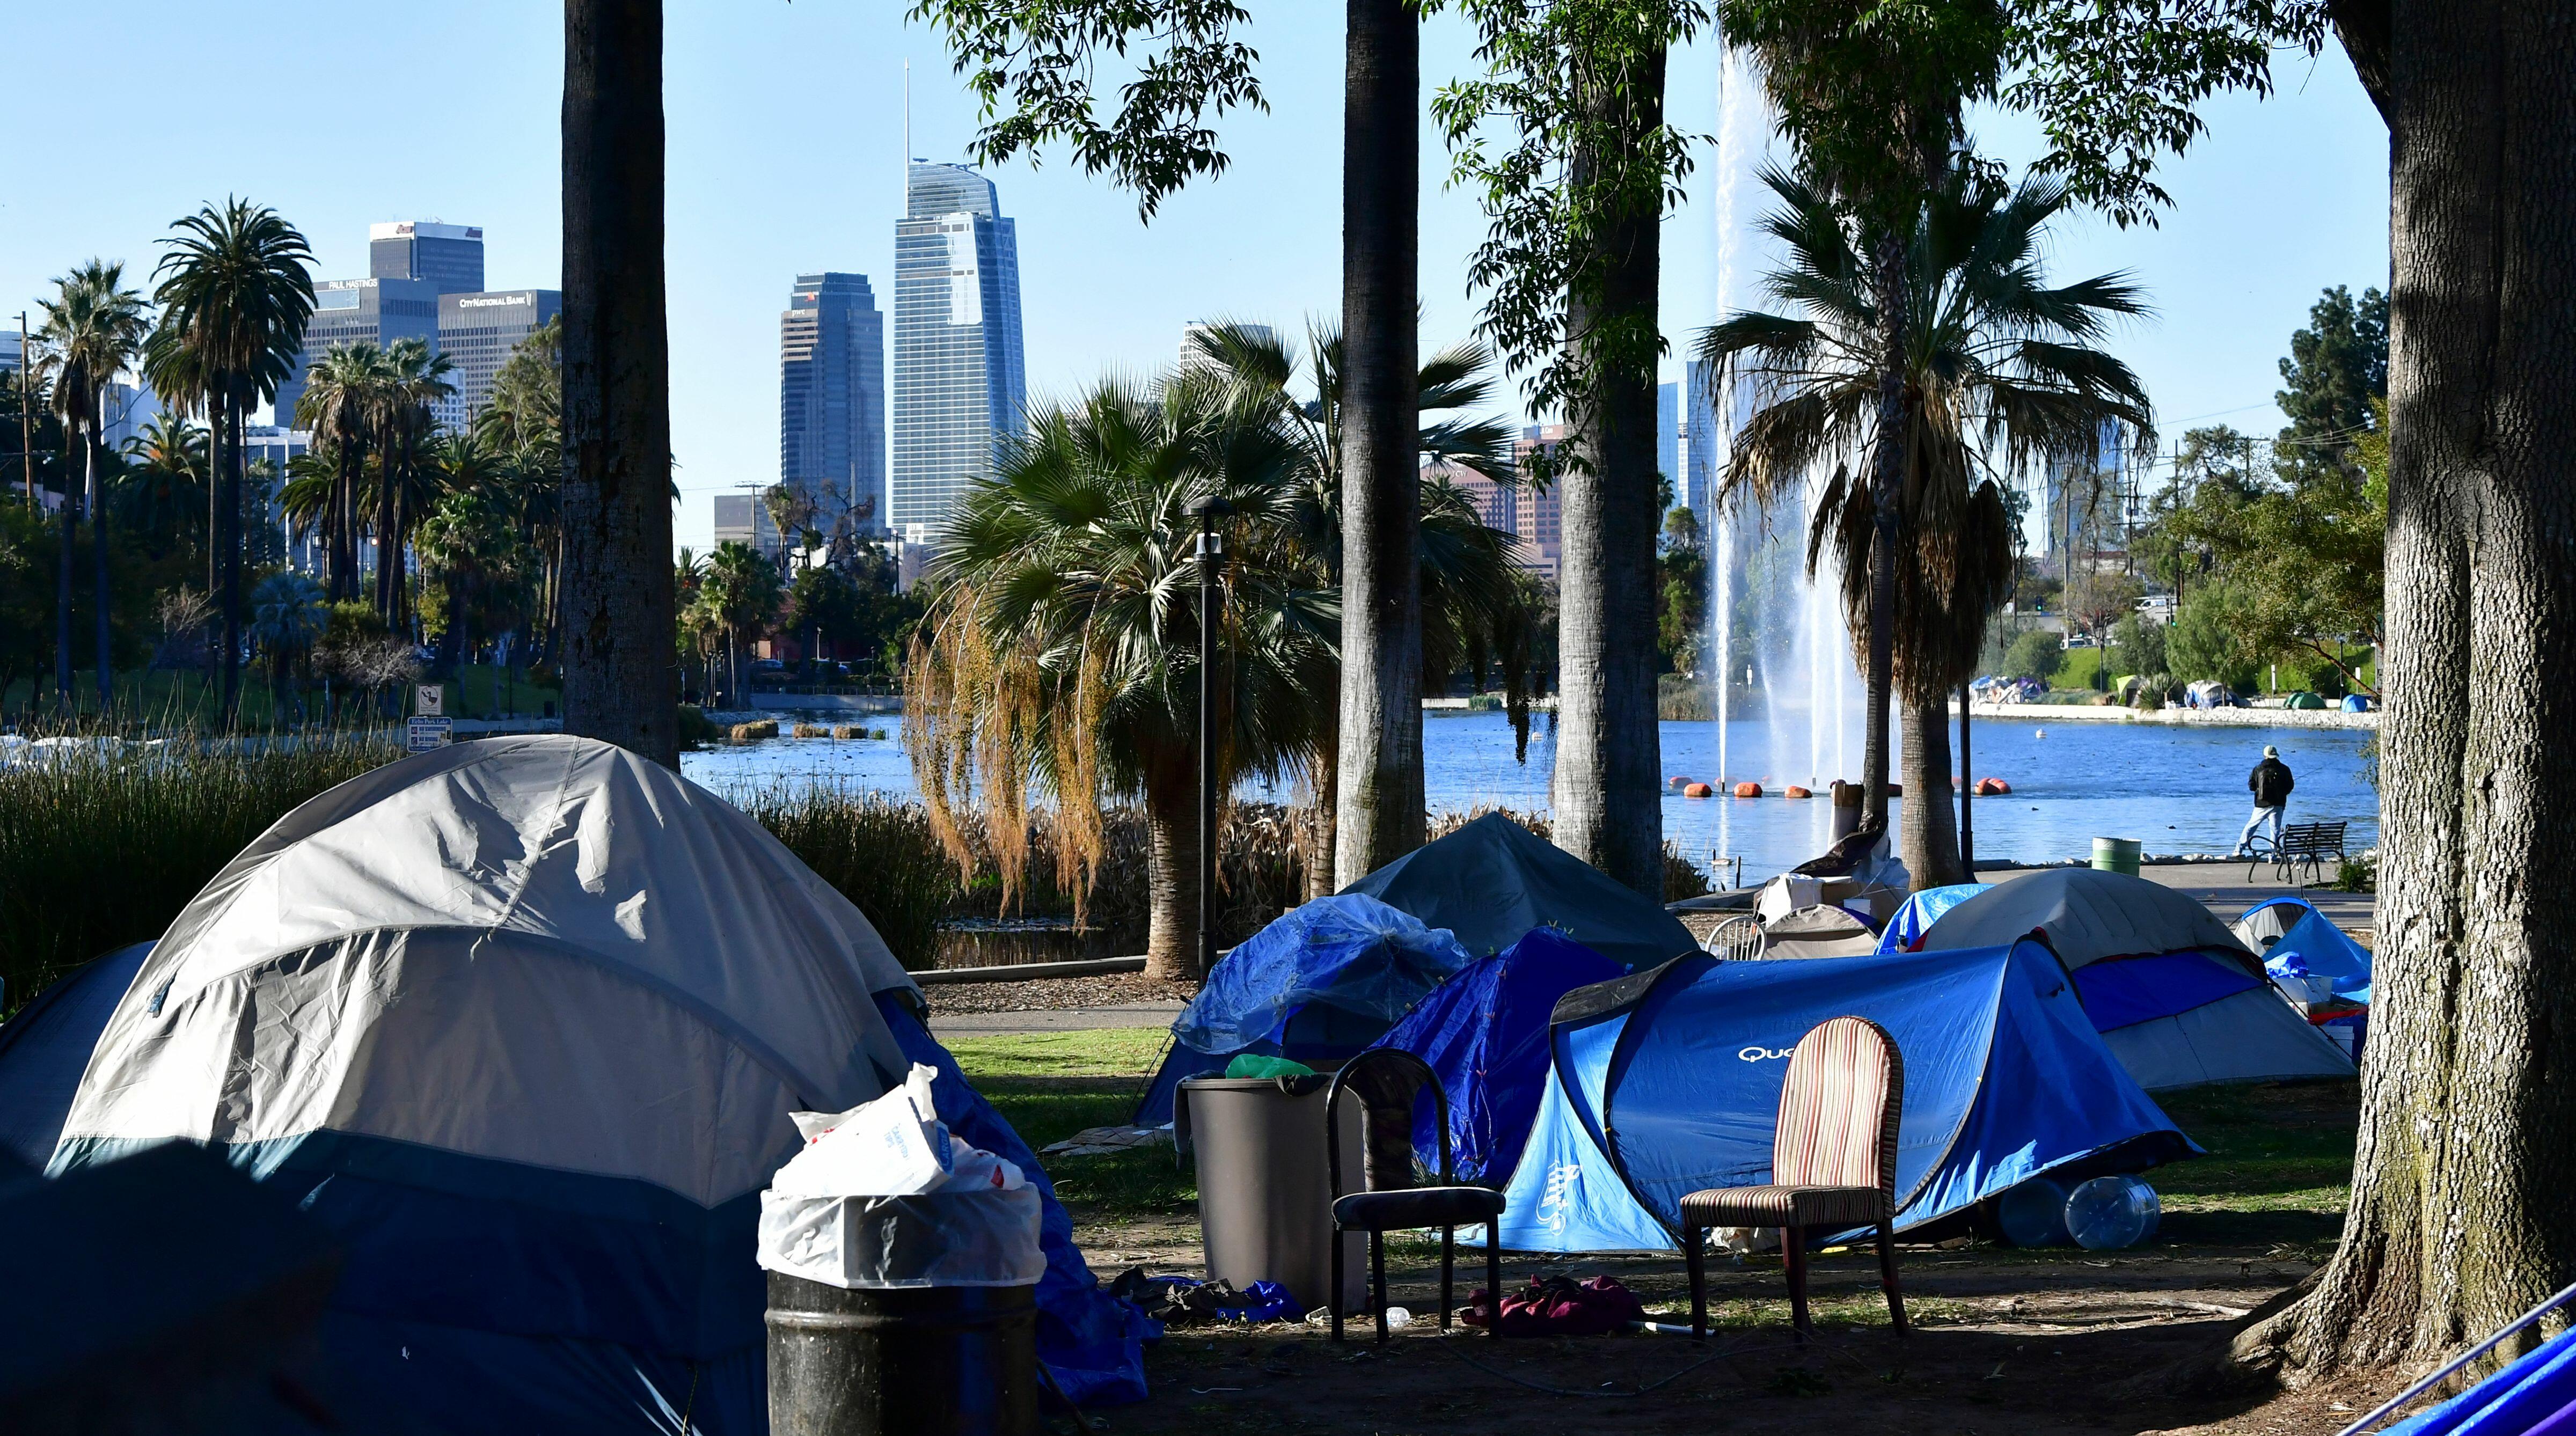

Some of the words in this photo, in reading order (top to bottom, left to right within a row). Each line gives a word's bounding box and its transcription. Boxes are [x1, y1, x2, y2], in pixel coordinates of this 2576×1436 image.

[329, 281, 345, 289] PAUL
[346, 279, 378, 288] HASTINGS
[939, 1131, 950, 1166] LARGE
